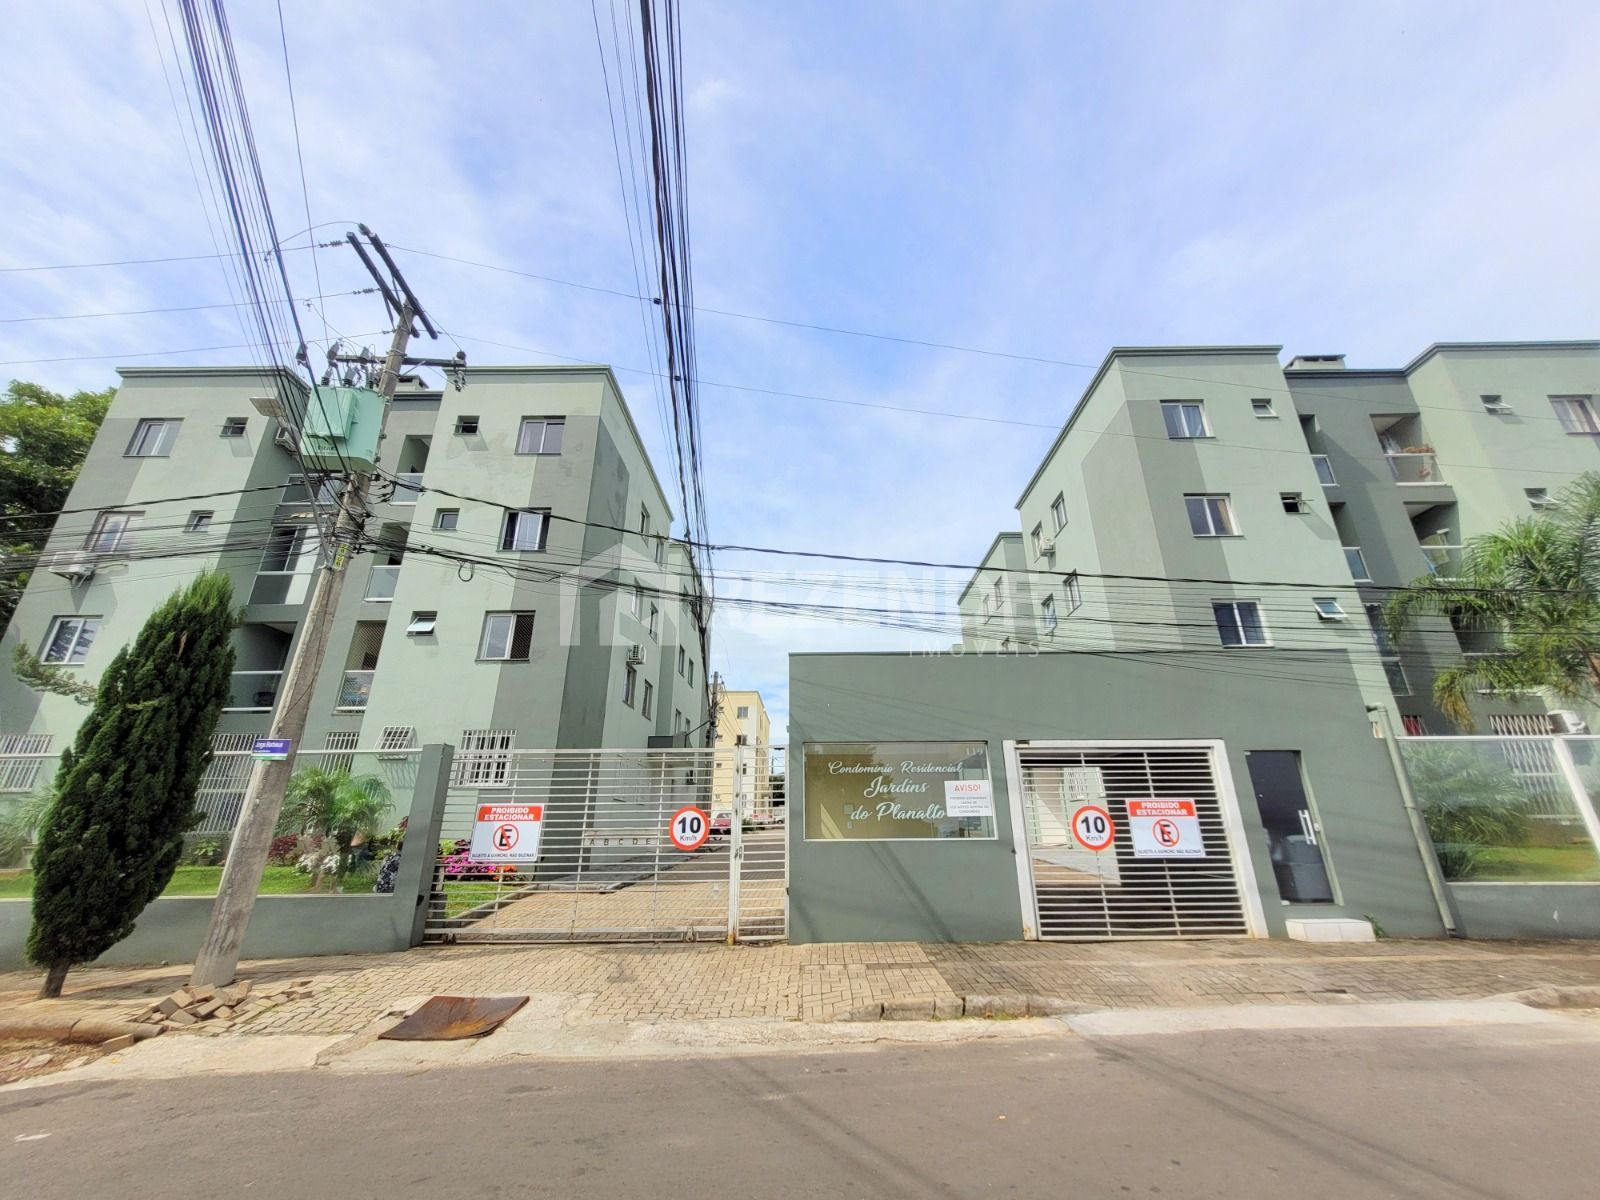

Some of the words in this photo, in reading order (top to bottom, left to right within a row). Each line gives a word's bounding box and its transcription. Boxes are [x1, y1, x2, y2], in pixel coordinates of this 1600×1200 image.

[900, 760, 963, 774] Residencial
[863, 775, 930, 798] Jardins
[954, 783, 982, 792] AVISO!
[484, 813, 534, 821] ESTACIONAR
[850, 804, 873, 820] do
[876, 801, 945, 821] Planalto
[1136, 808, 1188, 816] ESTACIONAR
[678, 816, 702, 834] 10
[1081, 815, 1106, 834] 10
